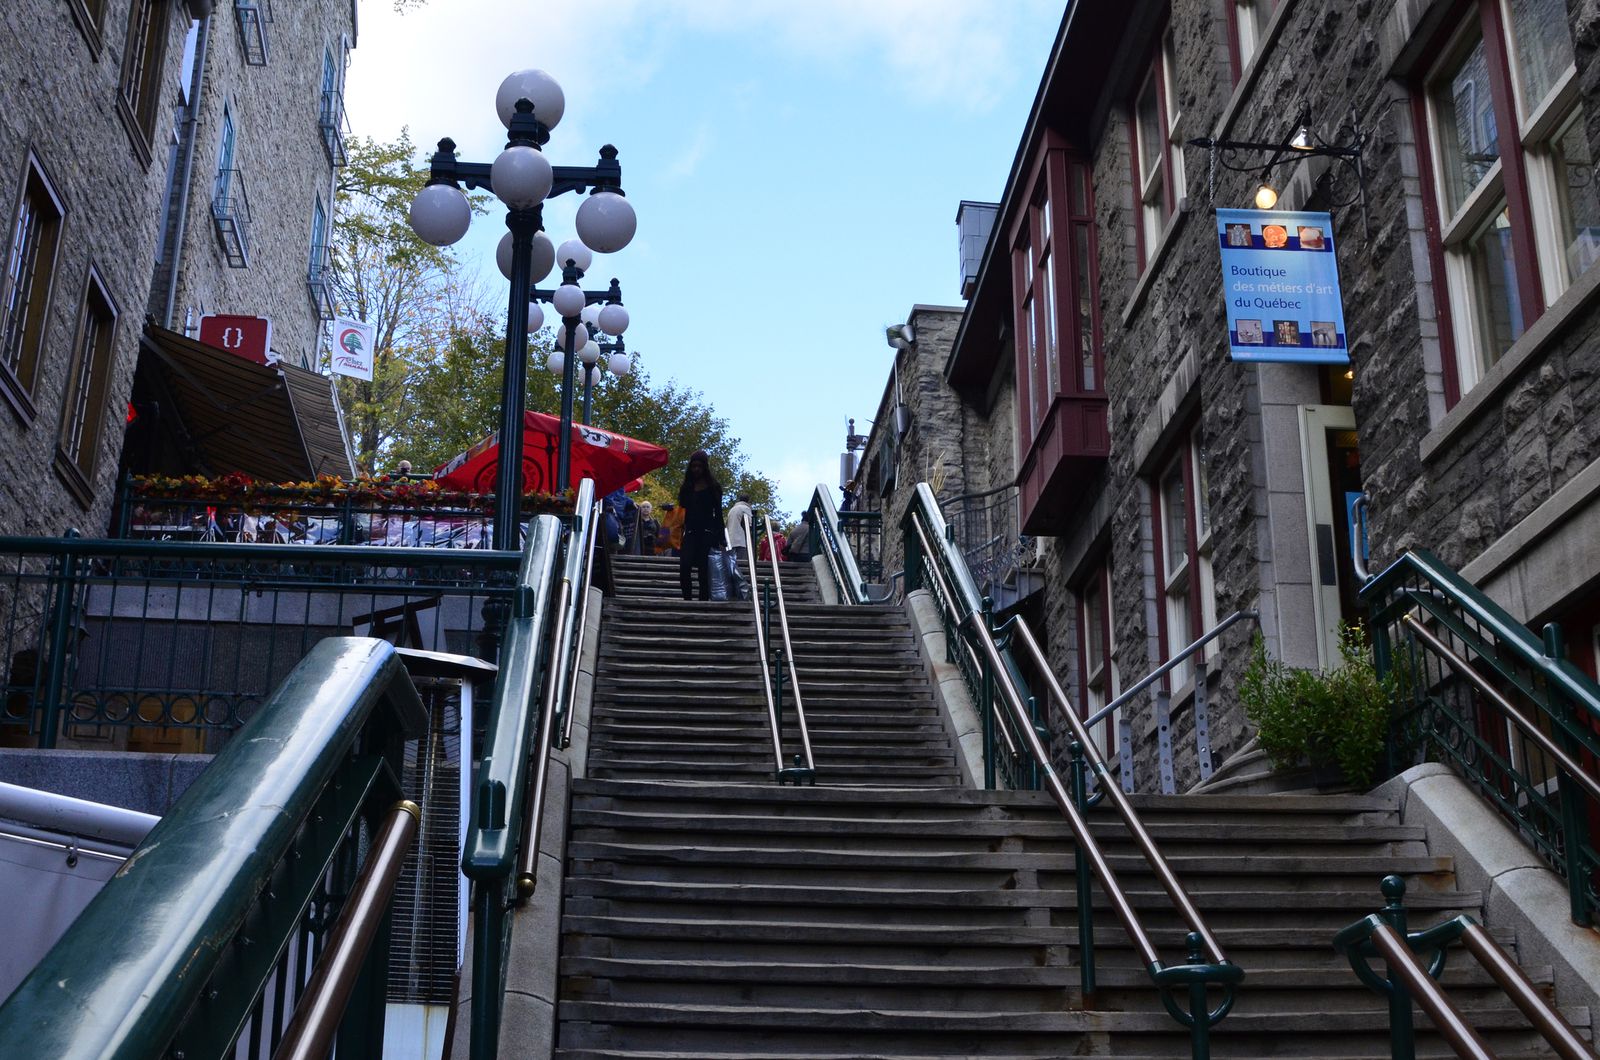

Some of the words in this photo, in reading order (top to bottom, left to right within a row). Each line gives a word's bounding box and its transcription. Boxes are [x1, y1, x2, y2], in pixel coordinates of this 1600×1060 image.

[1231, 265, 1287, 279] Boutique
[1232, 281, 1254, 292] des
[1257, 282, 1303, 294] métiers
[1305, 283, 1333, 295] d'art
[1234, 297, 1251, 308] du
[1253, 297, 1301, 309] Québec
